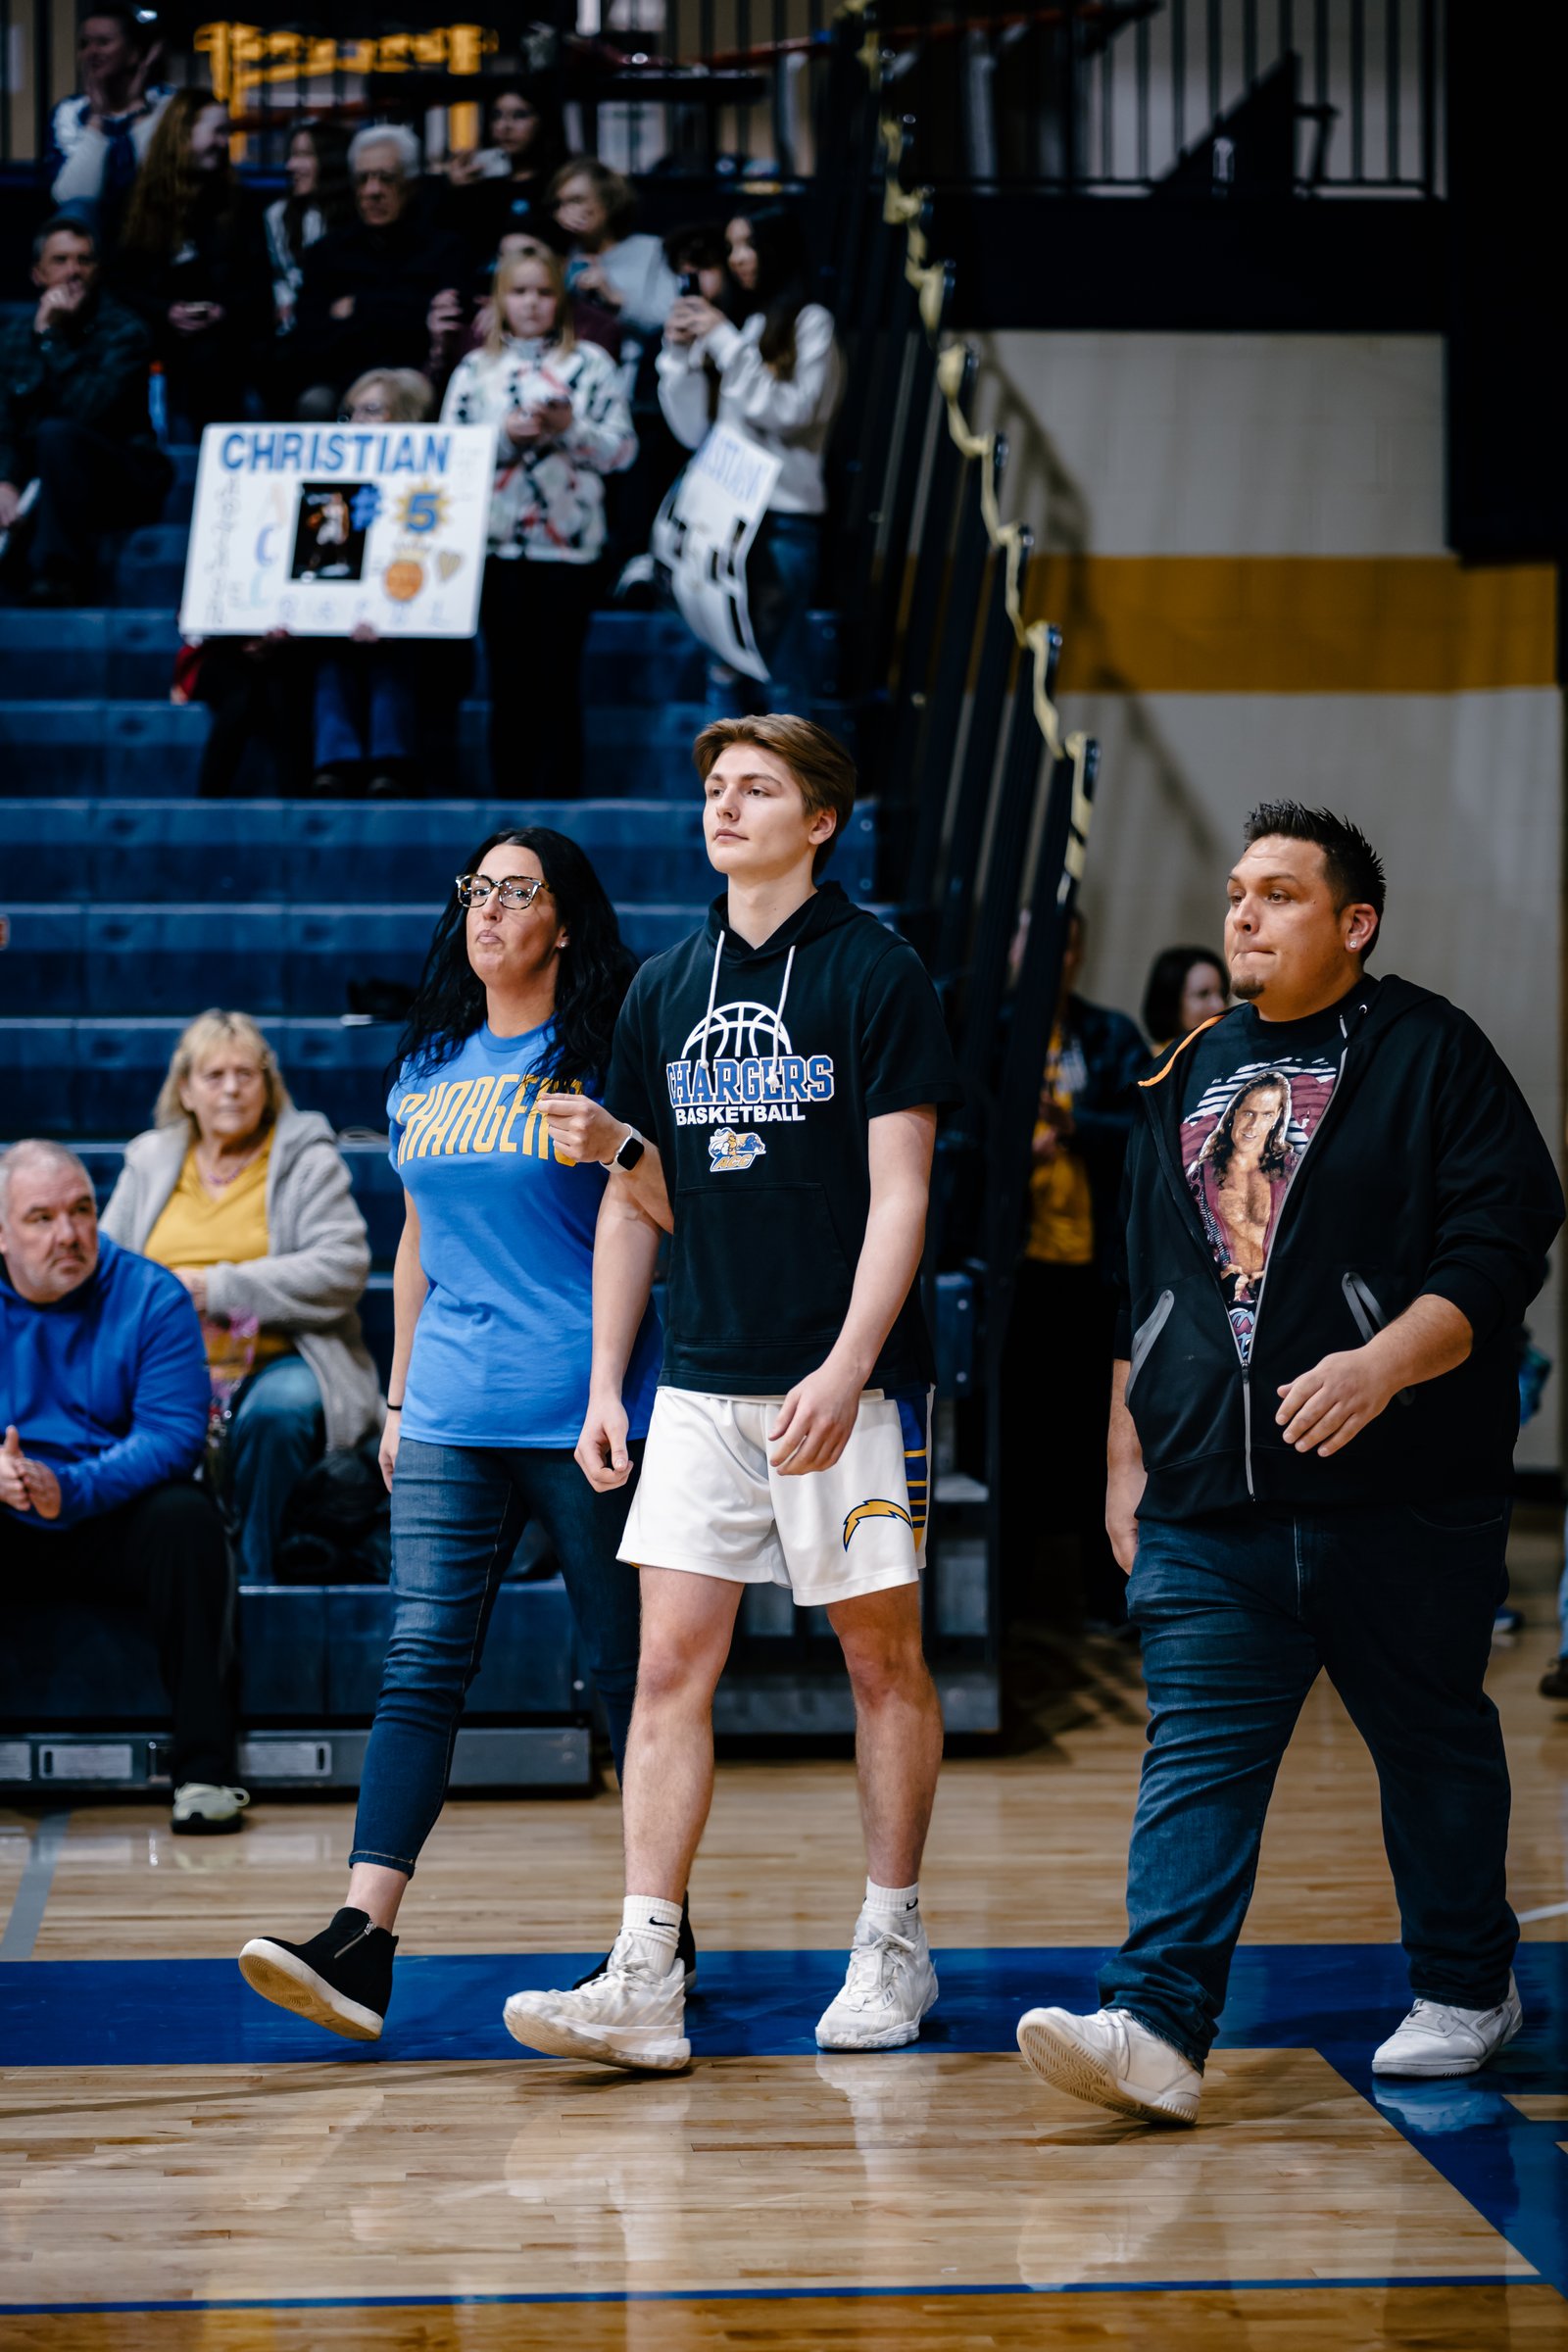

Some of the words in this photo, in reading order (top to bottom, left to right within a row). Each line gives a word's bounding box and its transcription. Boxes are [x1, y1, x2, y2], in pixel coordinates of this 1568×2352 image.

[220, 431, 452, 473] CHRISTIAN
[404, 492, 439, 533] 5
[666, 1054, 835, 1108] CHARGERS
[395, 1073, 583, 1169] CHARGER
[675, 1104, 806, 1126] BASKETBALL
[711, 1154, 754, 1170] ACC
